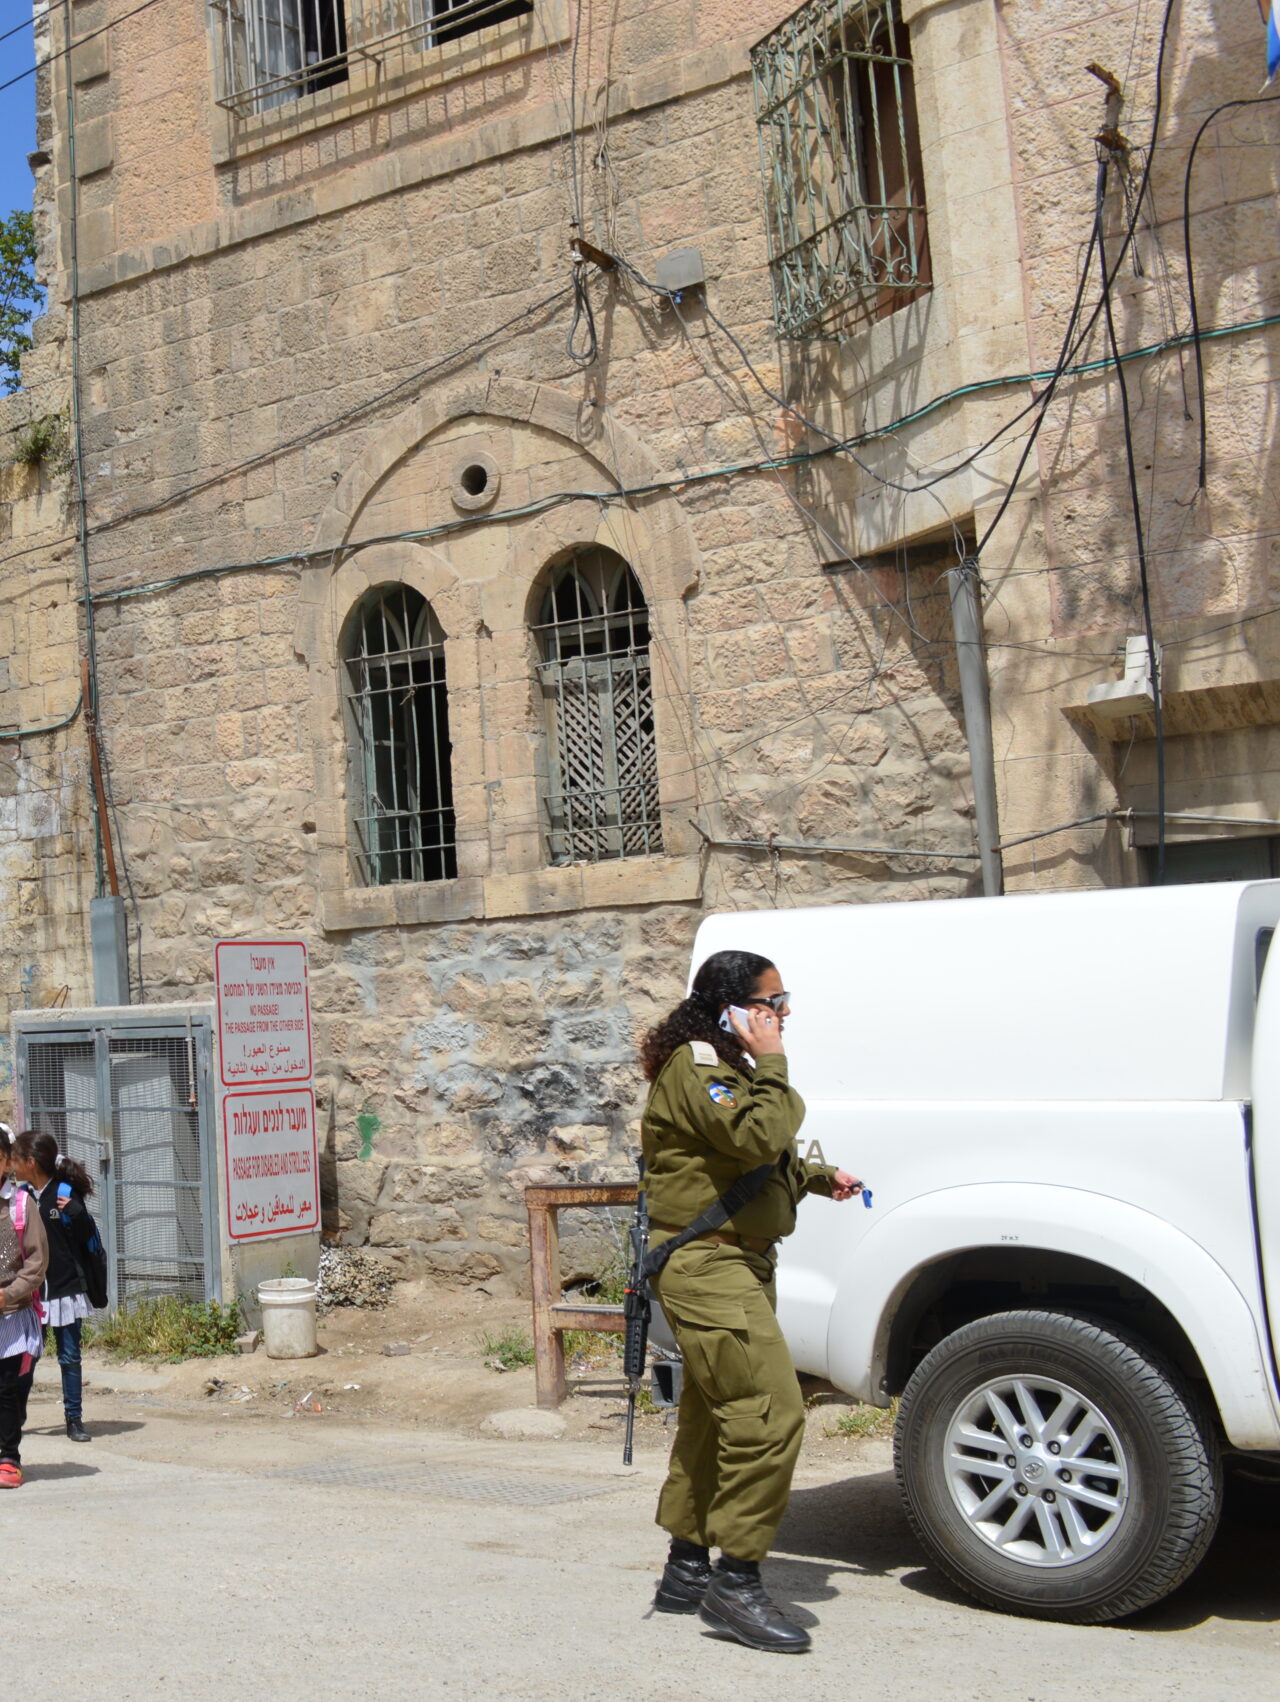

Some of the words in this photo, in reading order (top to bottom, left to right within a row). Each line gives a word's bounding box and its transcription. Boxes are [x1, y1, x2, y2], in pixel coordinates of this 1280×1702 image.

[267, 957, 276, 974] אין
[246, 979, 254, 996] של
[250, 1004, 257, 1016] NO
[225, 1022, 234, 1034] THE
[235, 1021, 256, 1033] PASSAGE
[256, 1021, 269, 1032] FROM
[270, 1020, 279, 1032] THE
[280, 1019, 294, 1031] OTHER
[294, 1019, 304, 1031] SIDE
[269, 1042, 291, 1058] ممنوع
[272, 1063, 282, 1074] من
[233, 1104, 260, 1136] ועגלות
[262, 1101, 284, 1133] לנכים
[286, 1107, 307, 1132] מעבר
[233, 1156, 252, 1180] PASSAGE
[252, 1155, 260, 1179] FOR
[260, 1153, 280, 1178] DISABLED
[280, 1152, 288, 1176] AND
[289, 1150, 310, 1175] STROLLERS
[297, 1200, 312, 1219] معبر
